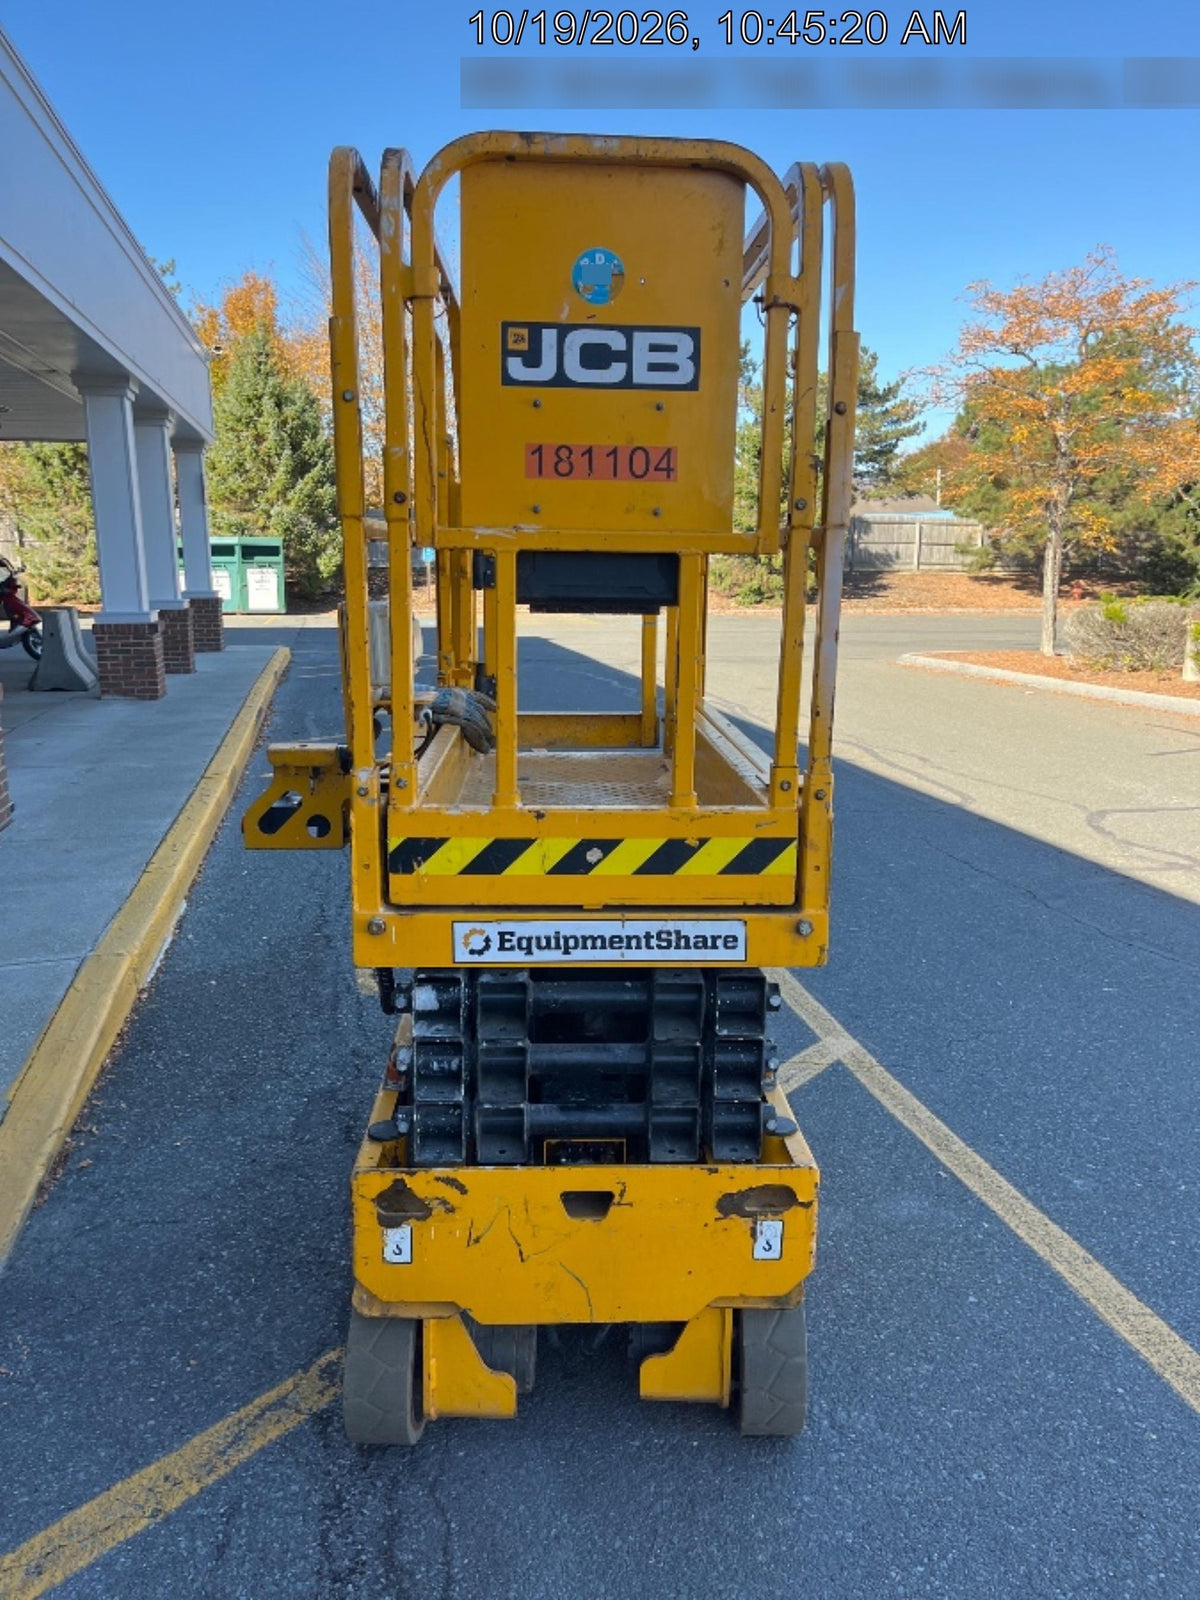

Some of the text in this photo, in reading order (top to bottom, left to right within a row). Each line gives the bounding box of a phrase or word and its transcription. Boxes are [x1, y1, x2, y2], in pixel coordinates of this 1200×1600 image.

[507, 328, 695, 385] JCB
[530, 445, 675, 479] 181104
[497, 931, 739, 956] EquipmentShare
